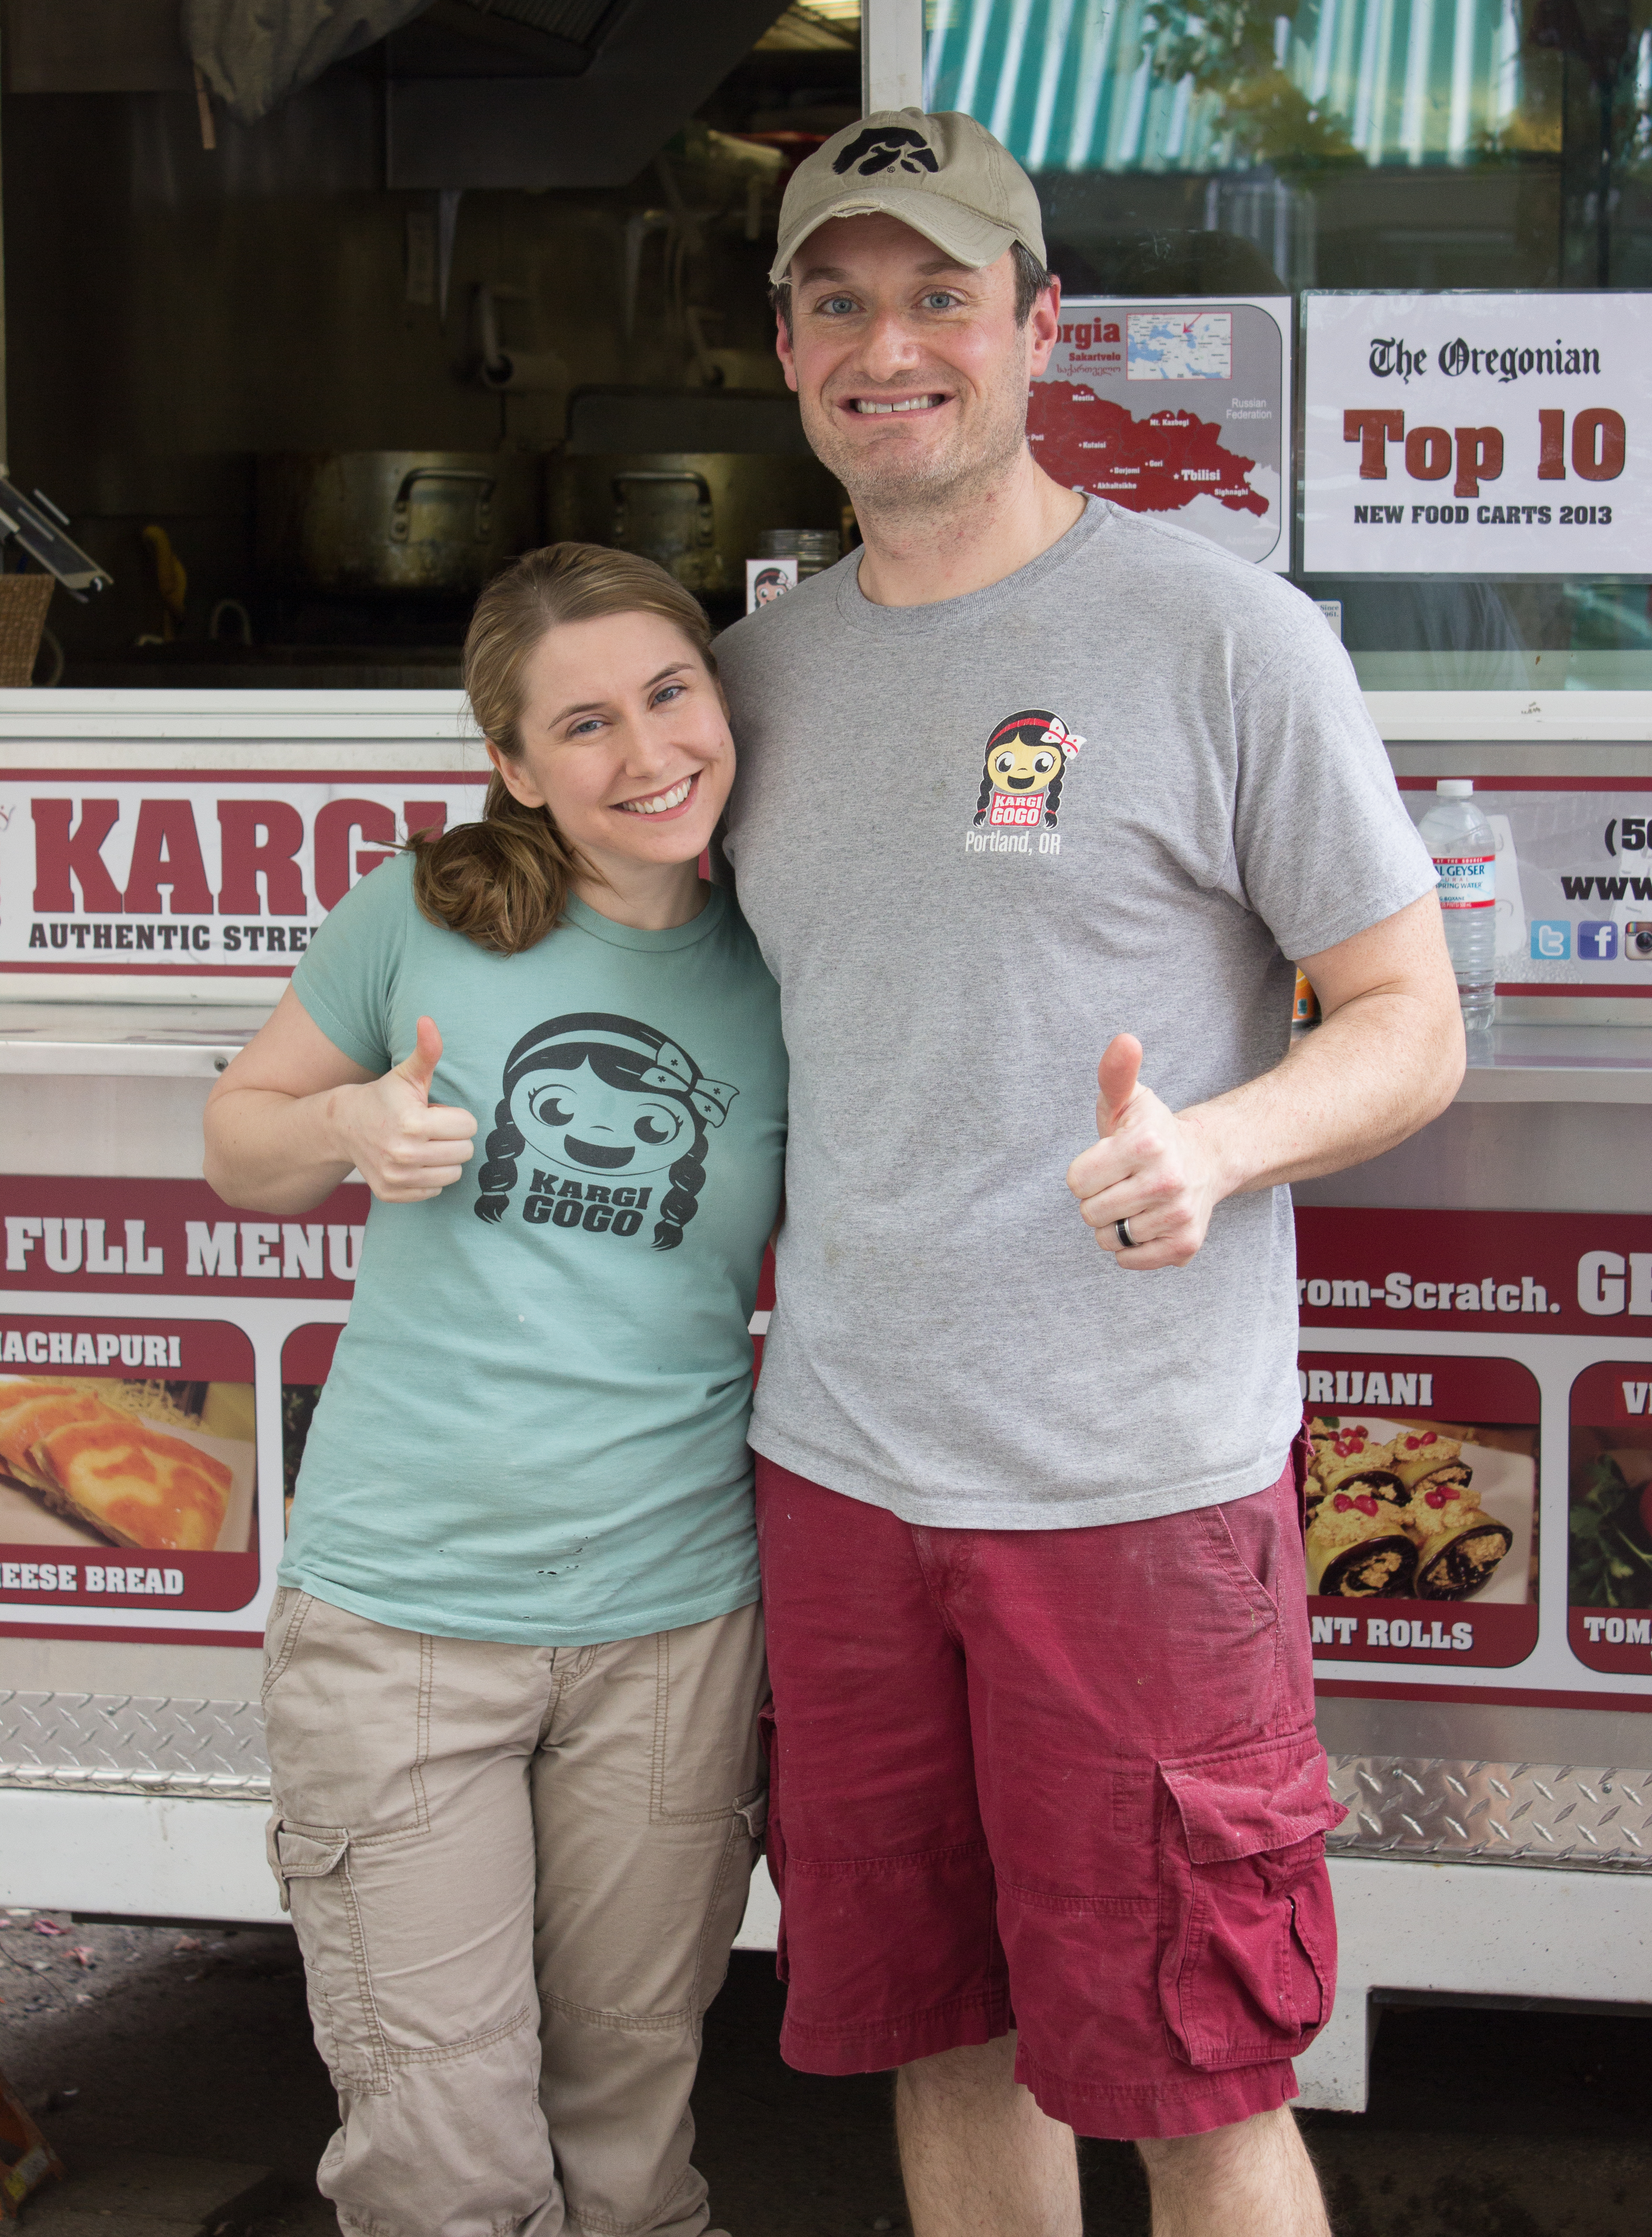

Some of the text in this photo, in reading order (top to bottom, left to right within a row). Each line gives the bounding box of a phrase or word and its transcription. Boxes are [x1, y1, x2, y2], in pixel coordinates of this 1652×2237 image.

[1055, 316, 1120, 350] rgia
[1069, 352, 1121, 361] Sakartvelo
[1369, 337, 1601, 384] The Oregonian
[1226, 409, 1272, 419] Federation
[1232, 398, 1266, 408] Russian
[1163, 419, 1189, 427] Kazbegi
[1343, 408, 1626, 498] Top 10
[1114, 467, 1141, 475] Borjomi
[1181, 468, 1221, 481] Tbilisi
[1214, 488, 1249, 497] Sighnaghi
[1354, 505, 1612, 525] NEW FOOD CARTS 2013
[994, 795, 1043, 807] KARGI
[991, 808, 1039, 825] GOGO
[965, 830, 1061, 856] Portland, OR
[1446, 865, 1485, 876] GEYSER
[29, 923, 319, 952] AUTHENTIC STRE
[529, 1168, 653, 1210] KARGI
[522, 1195, 643, 1237] GOGO
[5, 1216, 365, 1282] FULL MENU
[0, 1331, 181, 1368] ACHAPURI
[0, 1563, 184, 1596] EESE BREAD
[1367, 1618, 1474, 1651] ROLLS
[1584, 1616, 1652, 1646] TOM
